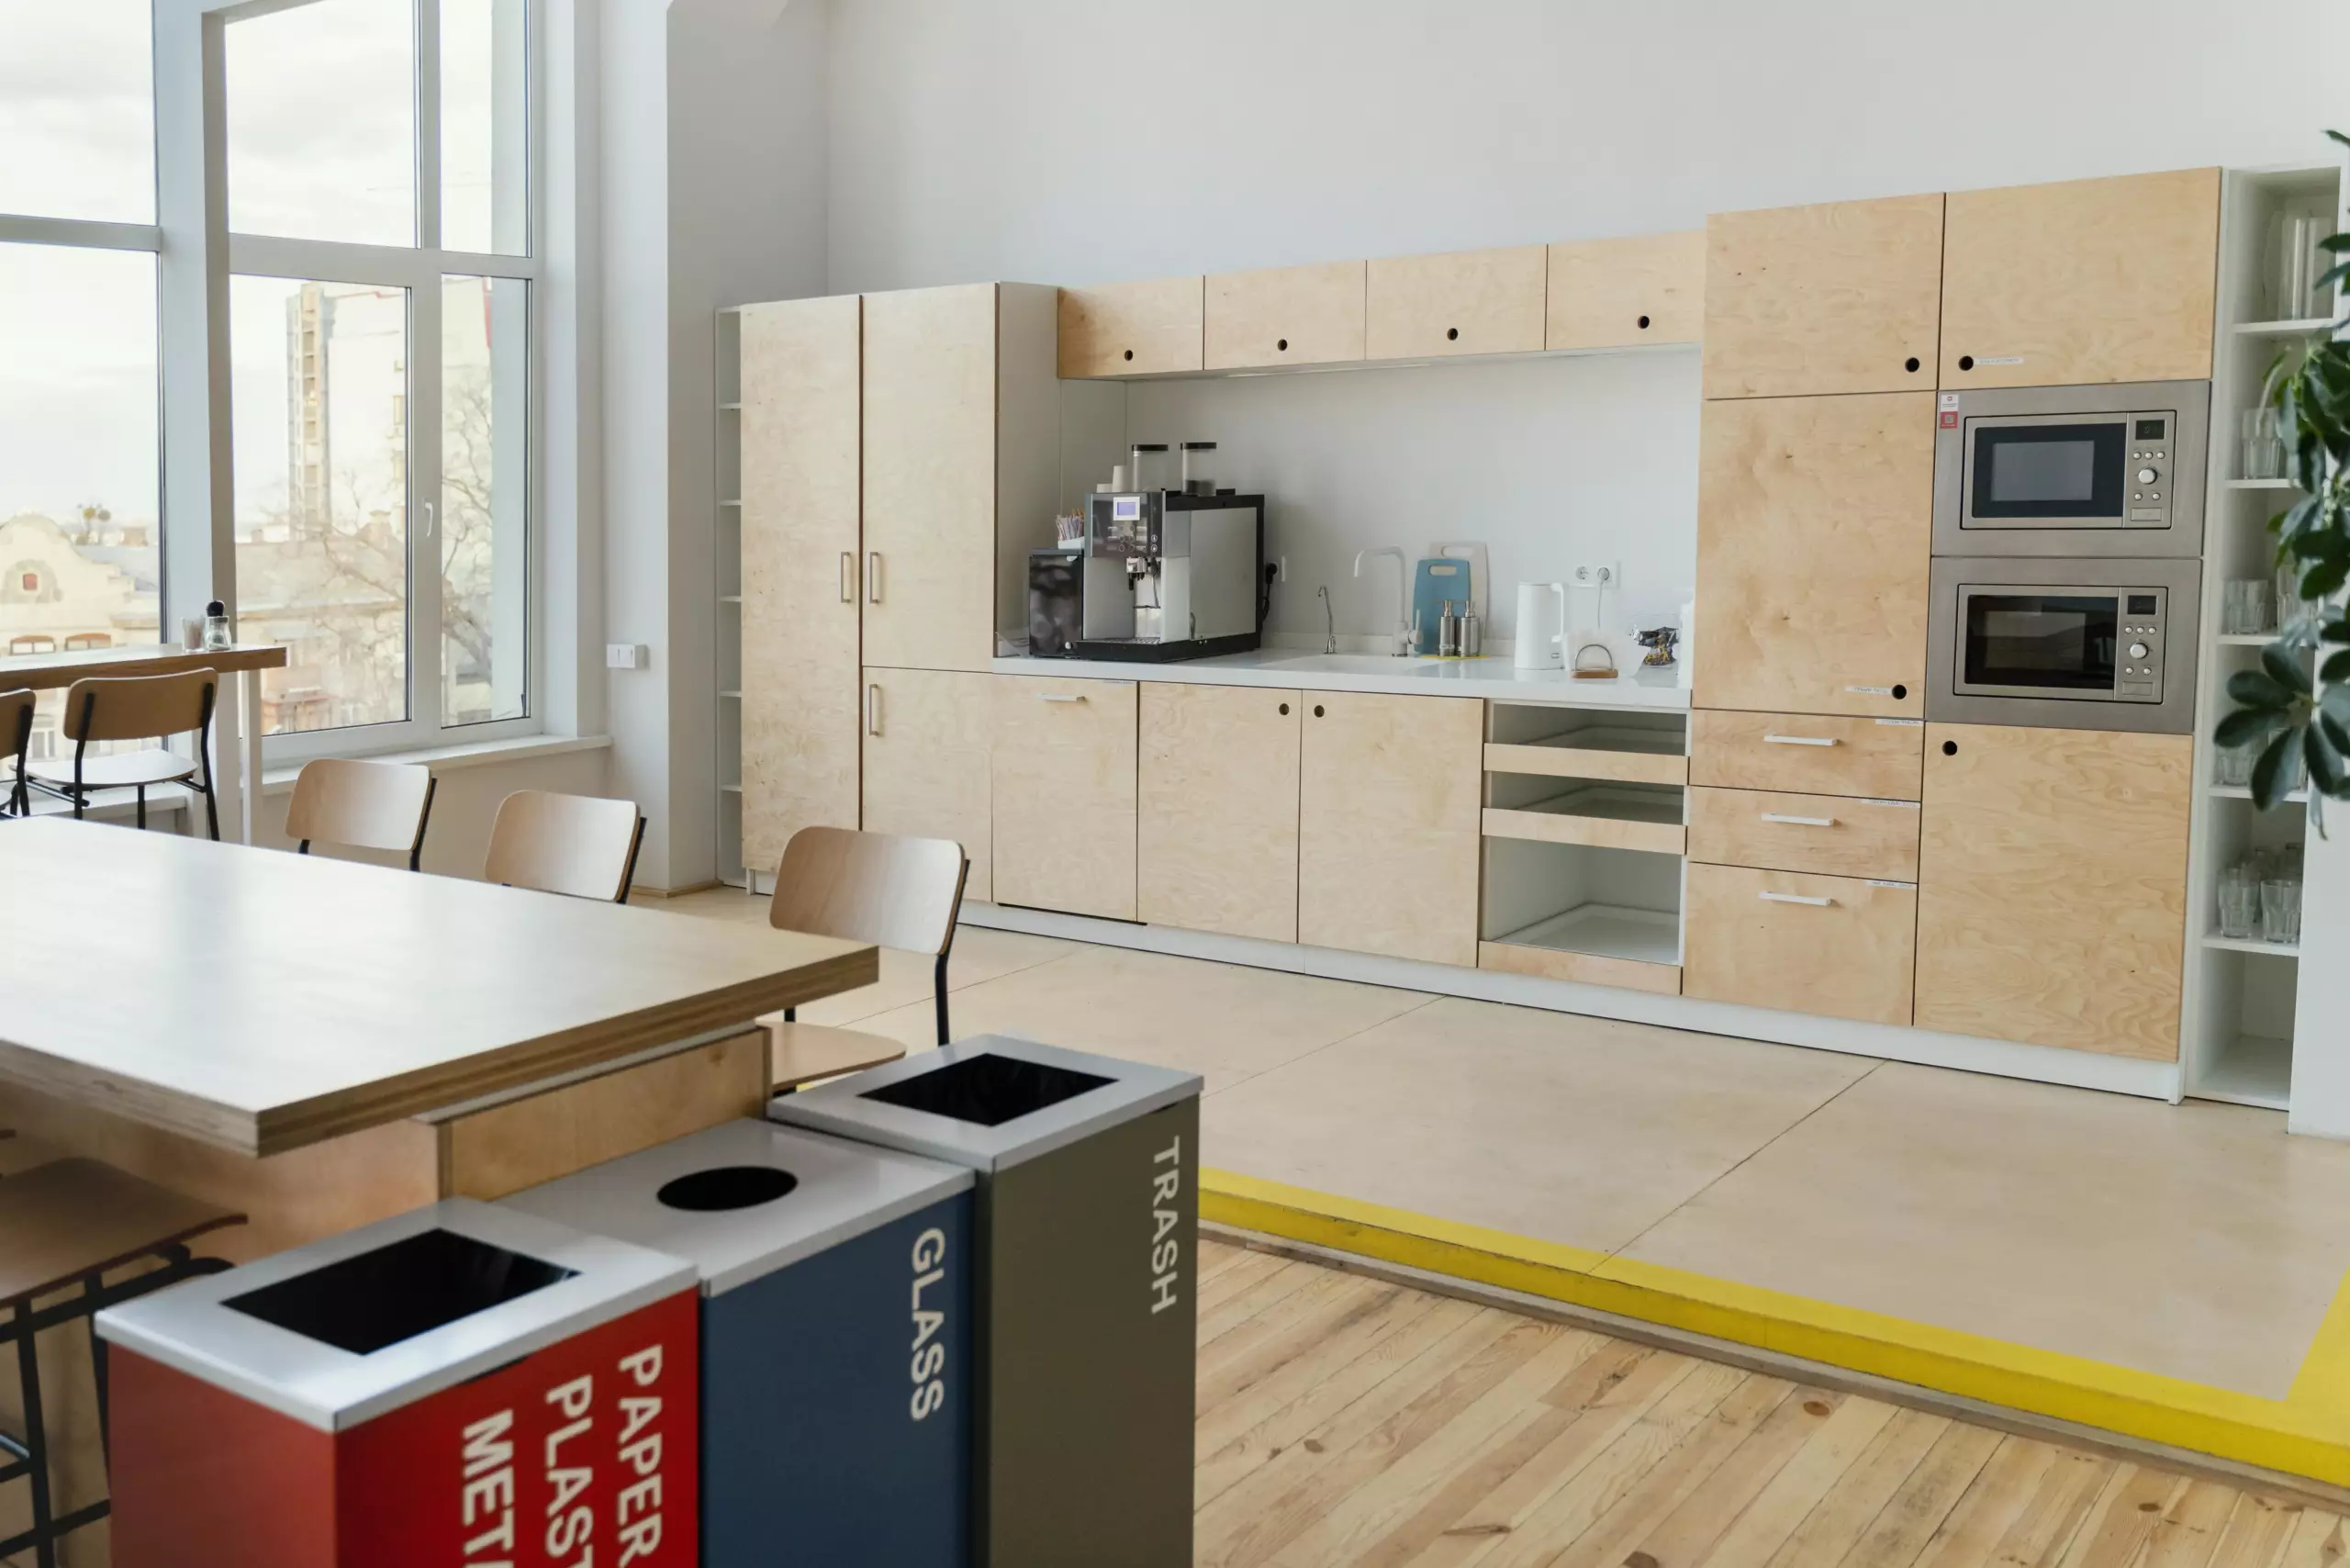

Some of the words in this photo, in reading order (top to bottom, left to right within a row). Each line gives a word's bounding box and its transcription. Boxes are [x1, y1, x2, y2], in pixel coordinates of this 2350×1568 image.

[1151, 1135, 1180, 1314] TRASH
[911, 1228, 946, 1420] GLASS
[463, 1409, 514, 1568] MET
[618, 1345, 663, 1568] PAPER
